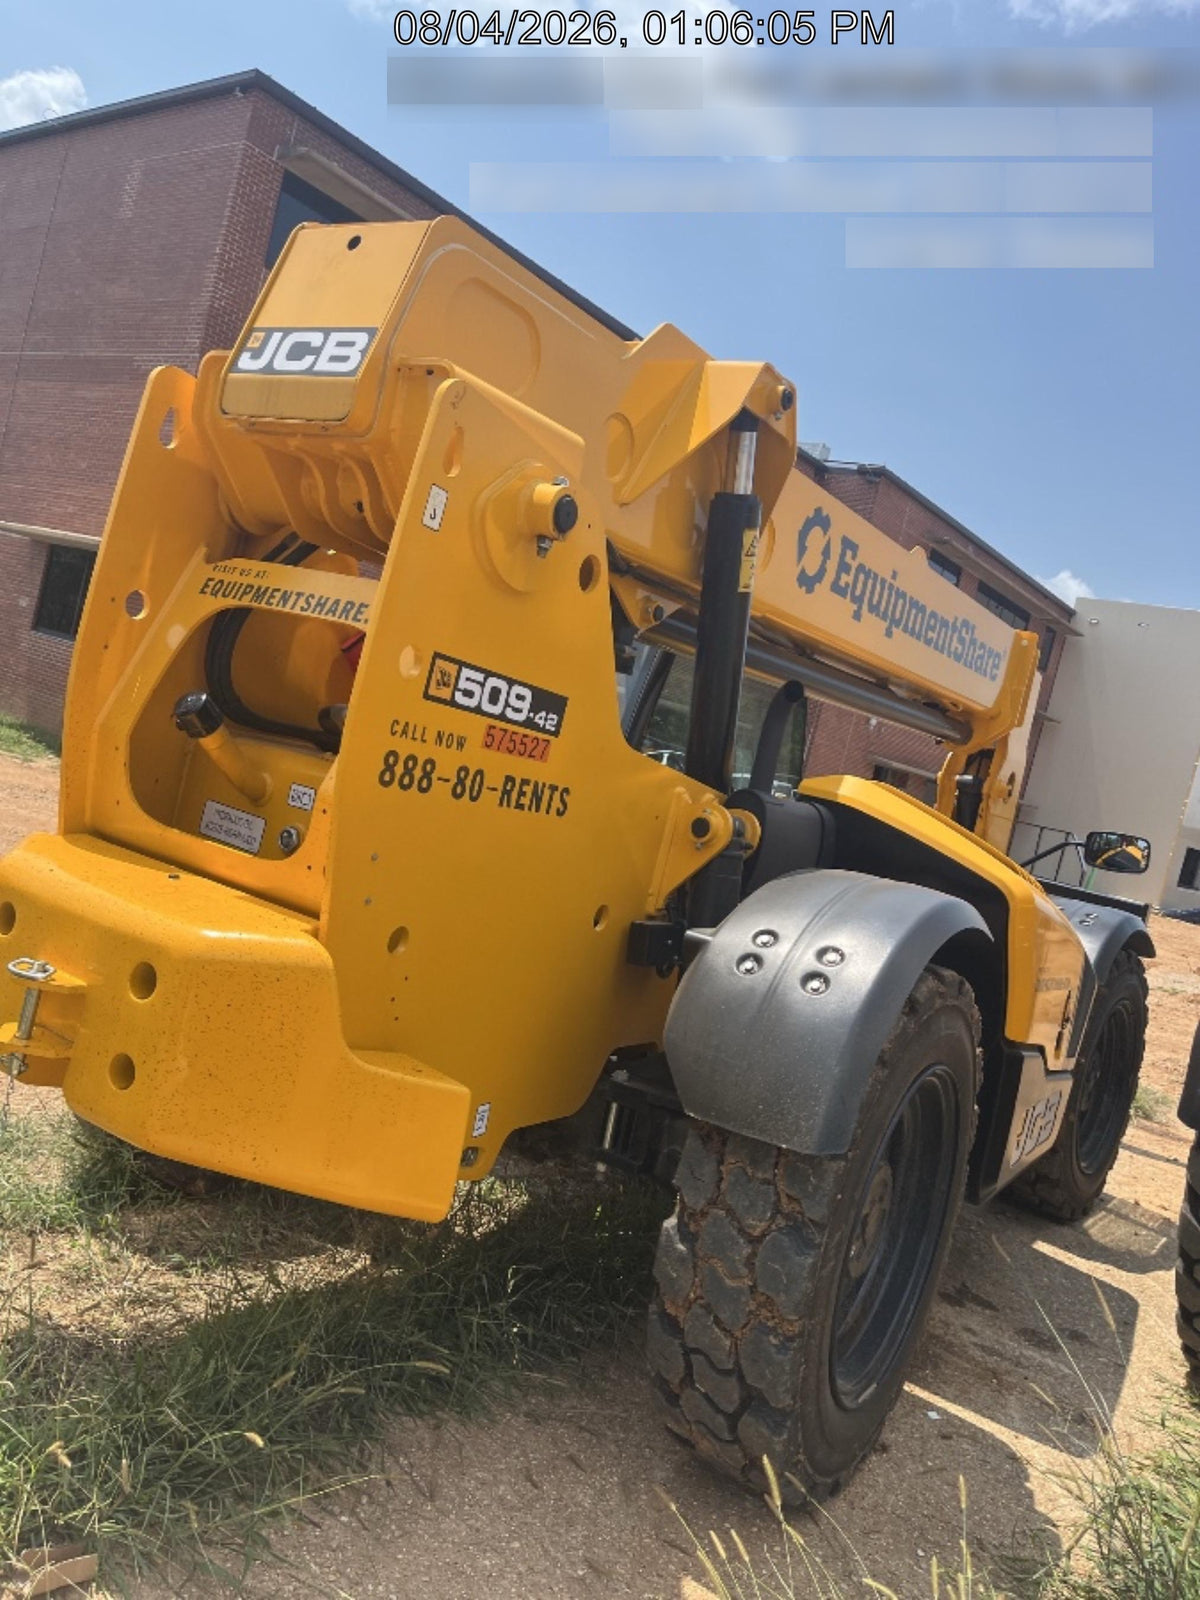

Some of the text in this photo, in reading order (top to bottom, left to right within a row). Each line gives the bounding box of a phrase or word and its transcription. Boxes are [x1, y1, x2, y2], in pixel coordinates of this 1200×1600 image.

[237, 331, 369, 373] JCB
[212, 564, 238, 575] VISIT
[830, 534, 1001, 683] EquipmentShare
[390, 719, 468, 752] CALL NOW
[484, 725, 550, 761] 575527
[378, 749, 571, 818] 888-80-RENTS
